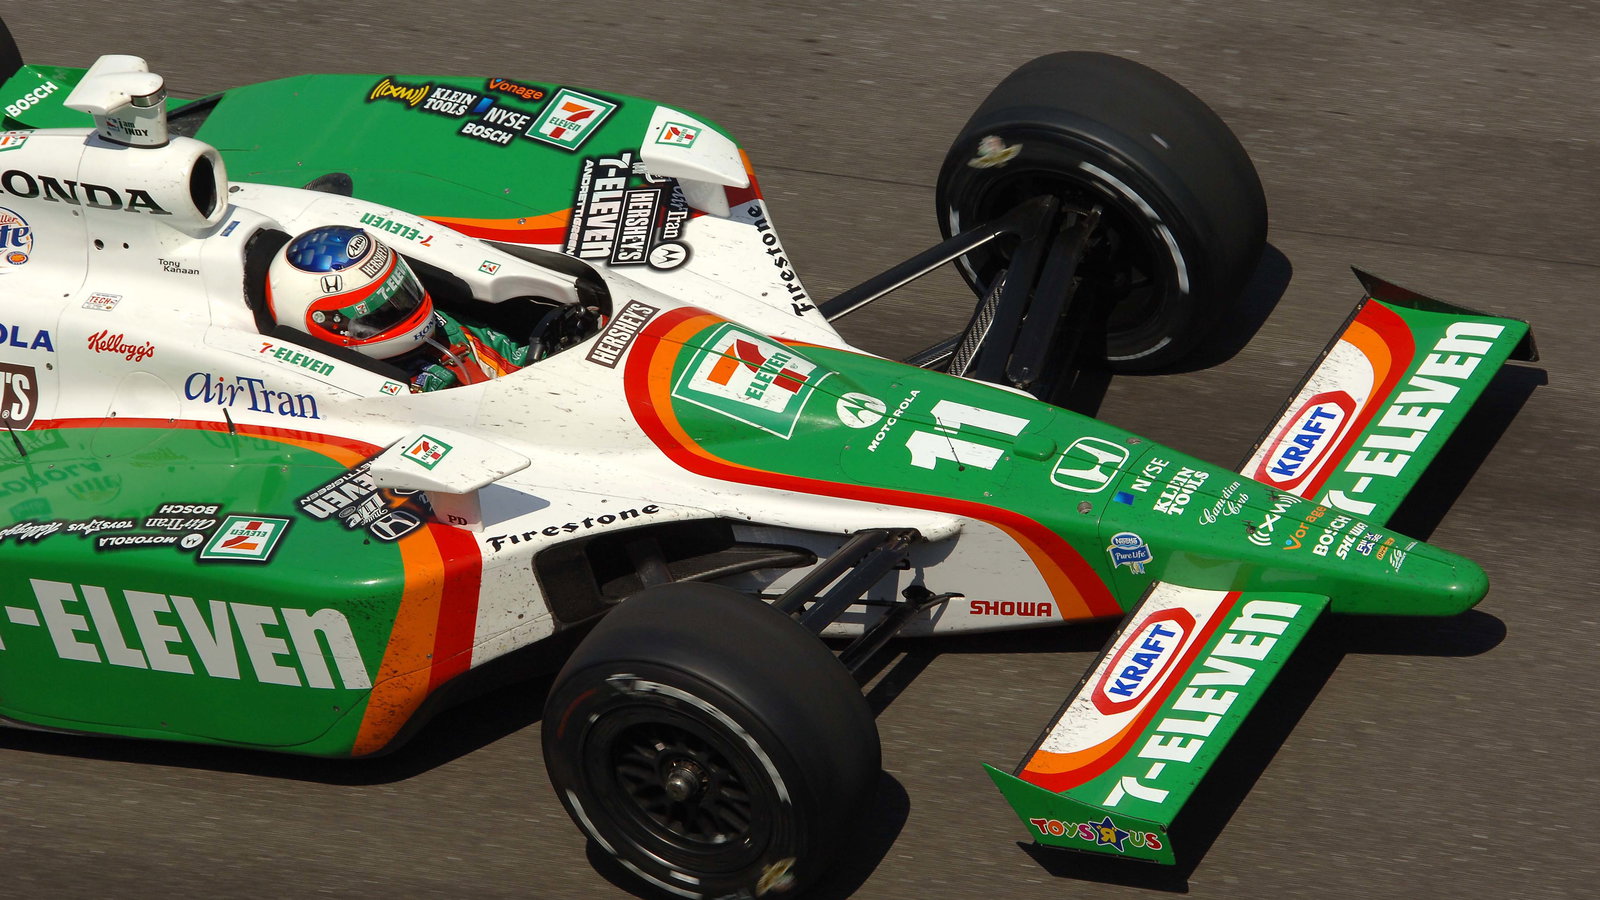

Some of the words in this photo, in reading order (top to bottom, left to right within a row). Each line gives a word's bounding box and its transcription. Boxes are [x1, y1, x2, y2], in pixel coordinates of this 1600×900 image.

[5, 81, 59, 118] BOSCH
[431, 87, 477, 106] KLEIN
[490, 78, 544, 100] Vonage
[424, 98, 467, 116] TOOLS
[483, 107, 531, 131] NYSE
[125, 127, 149, 137] INDY
[462, 122, 513, 144] BOSCH
[0, 169, 172, 216] ONDA
[618, 192, 655, 261] HERSHEY'S
[158, 258, 181, 268] Tony
[163, 265, 200, 275] Kanaan
[747, 201, 812, 315] Firestone
[87, 329, 155, 363] Kellogg's
[590, 302, 655, 366] HERSHEY'S
[867, 389, 921, 453] MOTOROLA
[905, 399, 1031, 471] 11
[1271, 406, 1337, 477] KRAFT
[1131, 457, 1170, 493] NYSE
[1153, 466, 1196, 514] KLEIN
[159, 504, 219, 515] BOSCH
[1167, 470, 1210, 516] TOOLS
[447, 514, 467, 527] PD
[486, 502, 660, 553] Firestone
[1312, 515, 1352, 557] BOSCH
[99, 536, 178, 547] MOTOROLA
[1114, 552, 1132, 561] Pure
[1132, 550, 1146, 559] Life
[969, 600, 1052, 617] SHOWA
[1109, 624, 1177, 697] KRAFT
